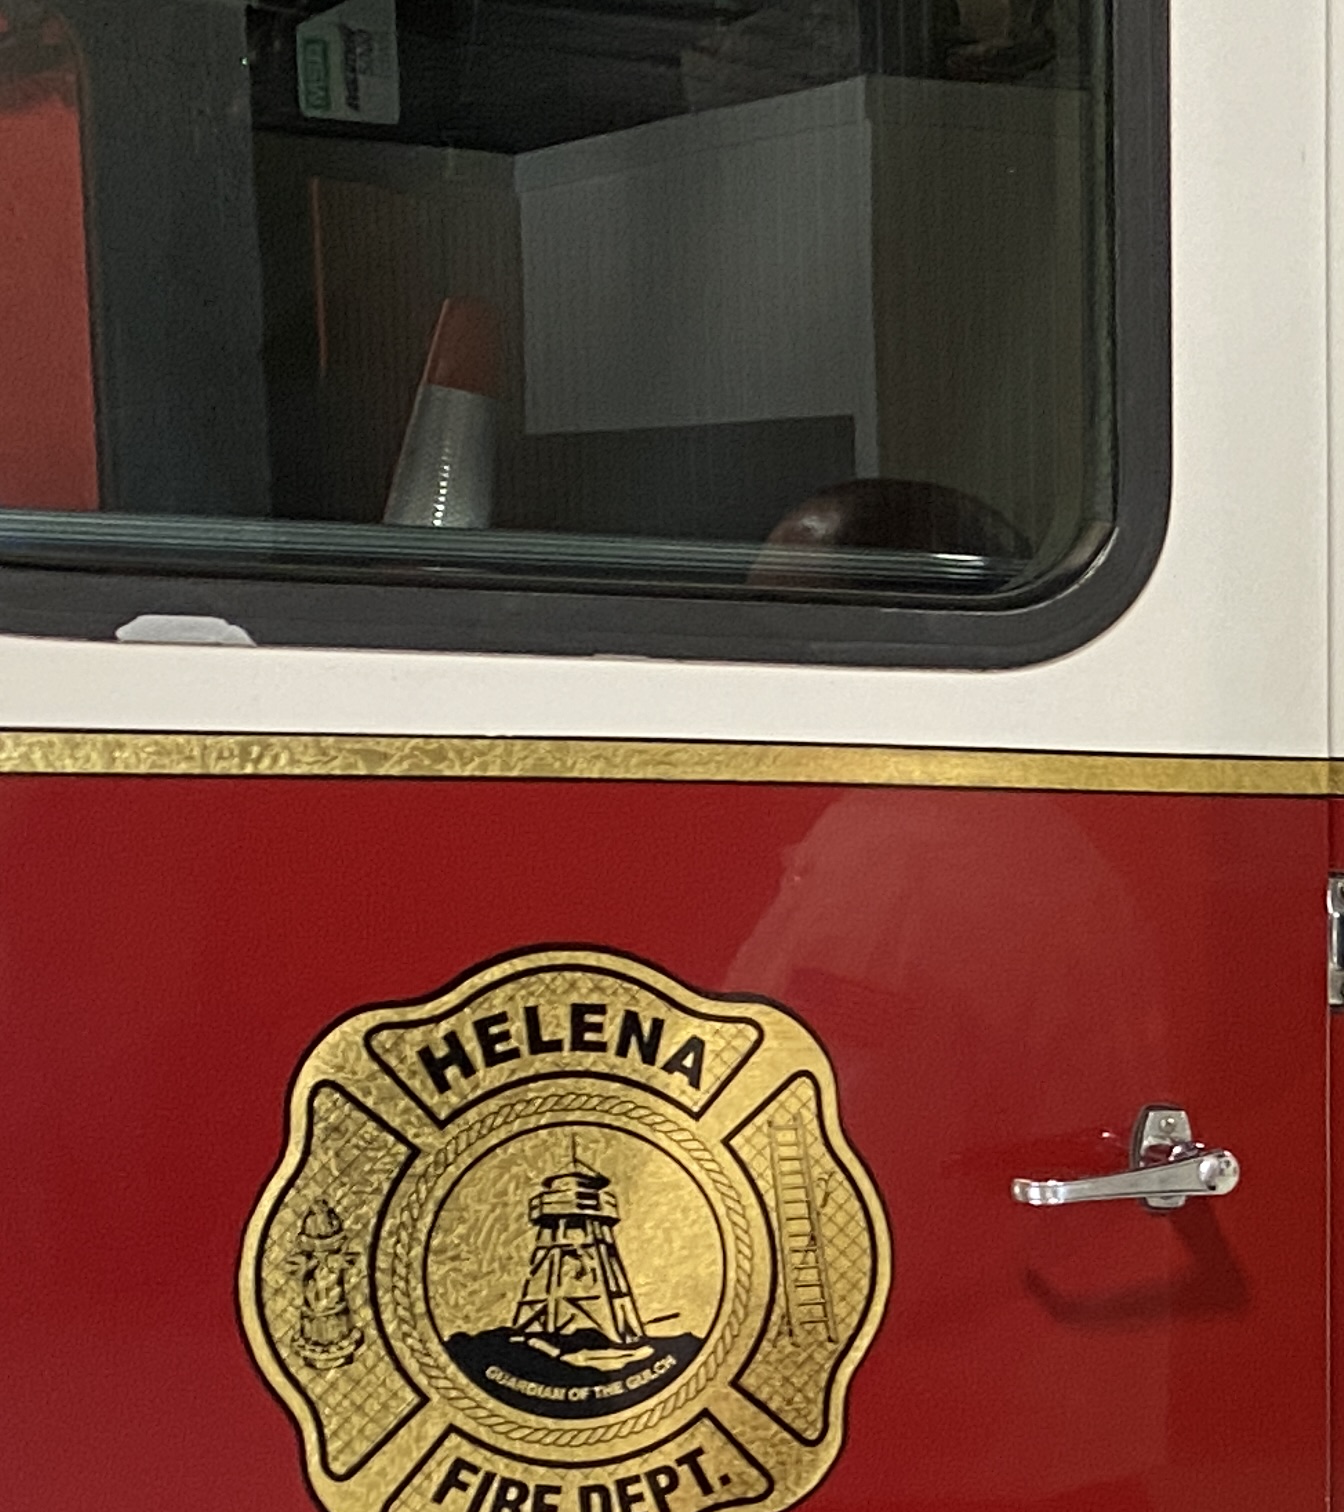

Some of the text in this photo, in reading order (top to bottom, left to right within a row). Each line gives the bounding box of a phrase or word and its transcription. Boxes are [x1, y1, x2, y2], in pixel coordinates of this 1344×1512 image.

[417, 1003, 708, 1094] HELENA
[485, 1354, 678, 1402] GUARDIAN OF THE GULCH
